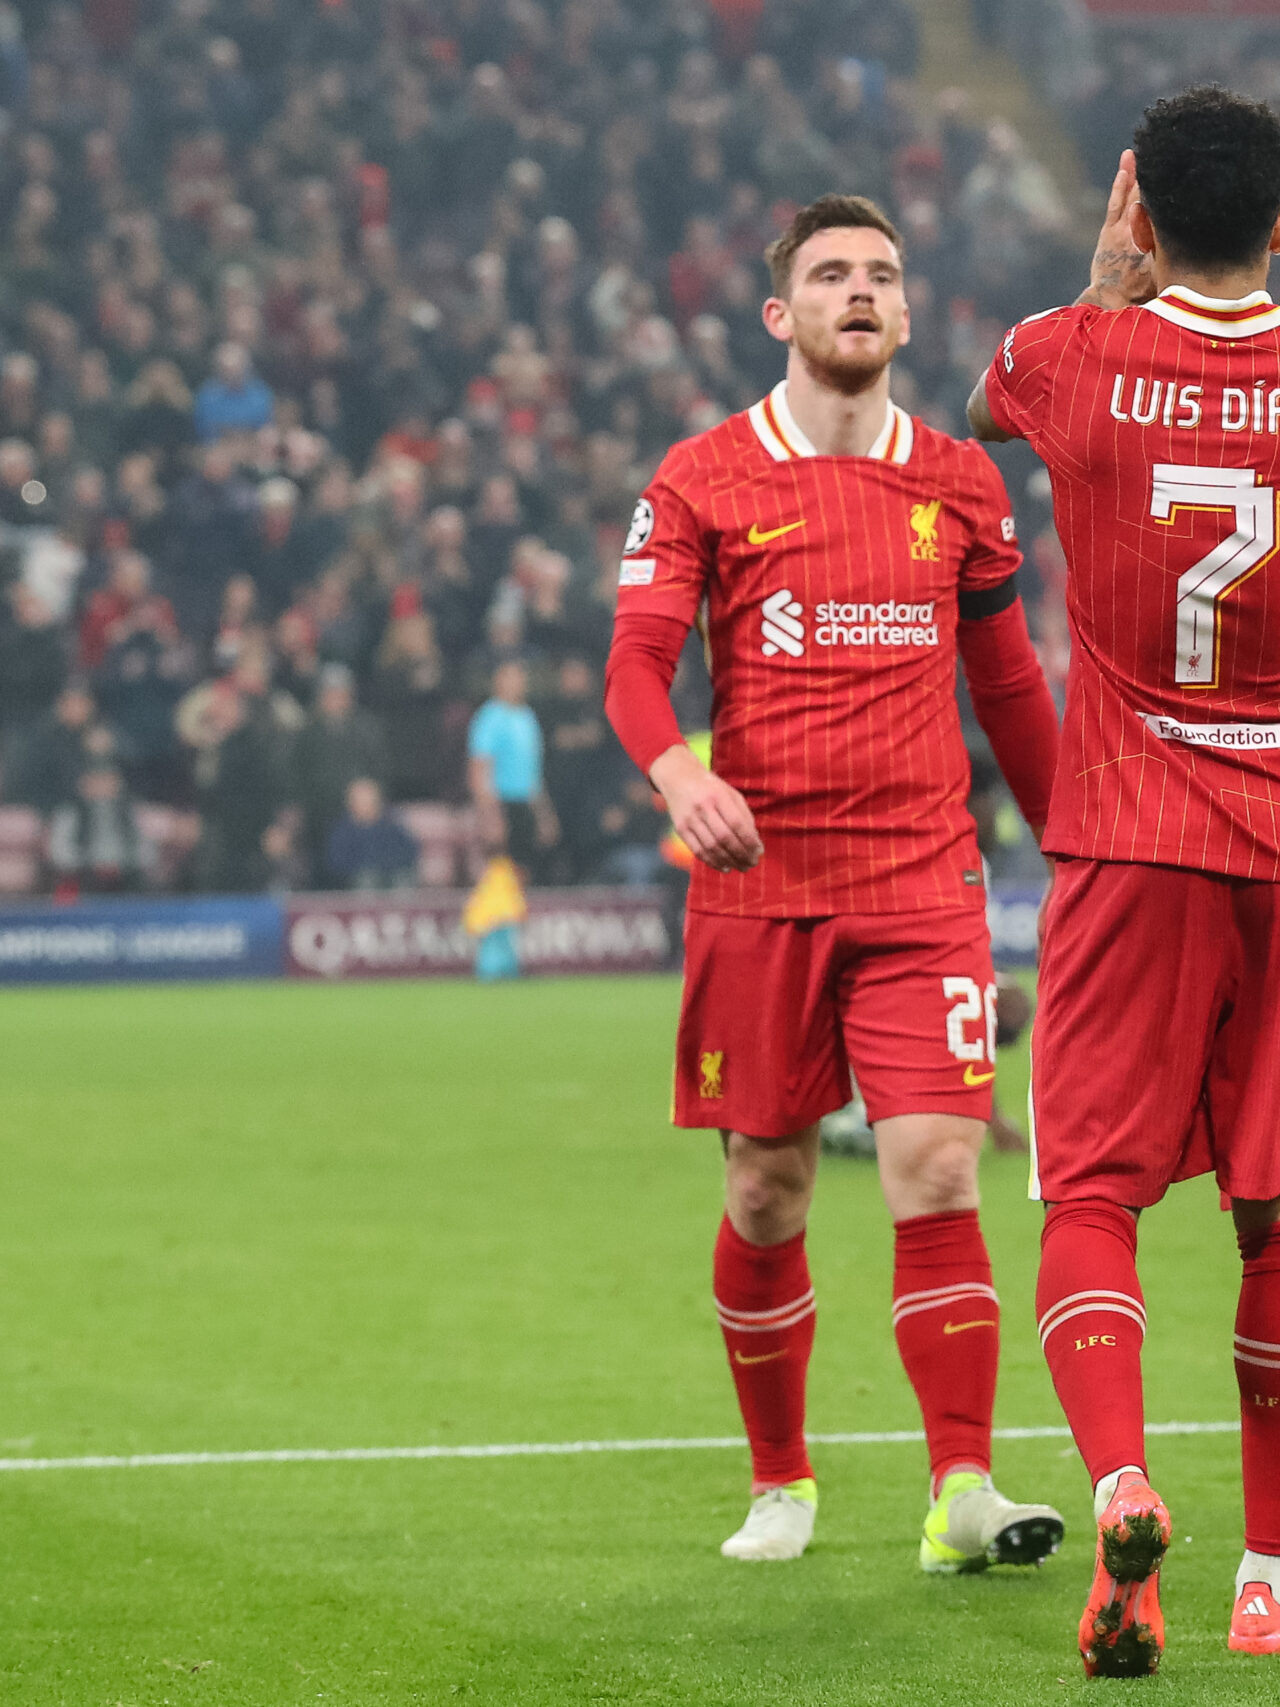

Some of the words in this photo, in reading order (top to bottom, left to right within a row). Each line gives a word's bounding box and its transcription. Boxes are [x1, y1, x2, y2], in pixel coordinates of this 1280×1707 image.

[1109, 373, 1204, 430] LUIS
[1150, 463, 1280, 689] 7
[815, 600, 936, 623] standard
[815, 623, 939, 647] chartered
[1158, 720, 1277, 745] Foundation
[1075, 1335, 1116, 1351] LFC
